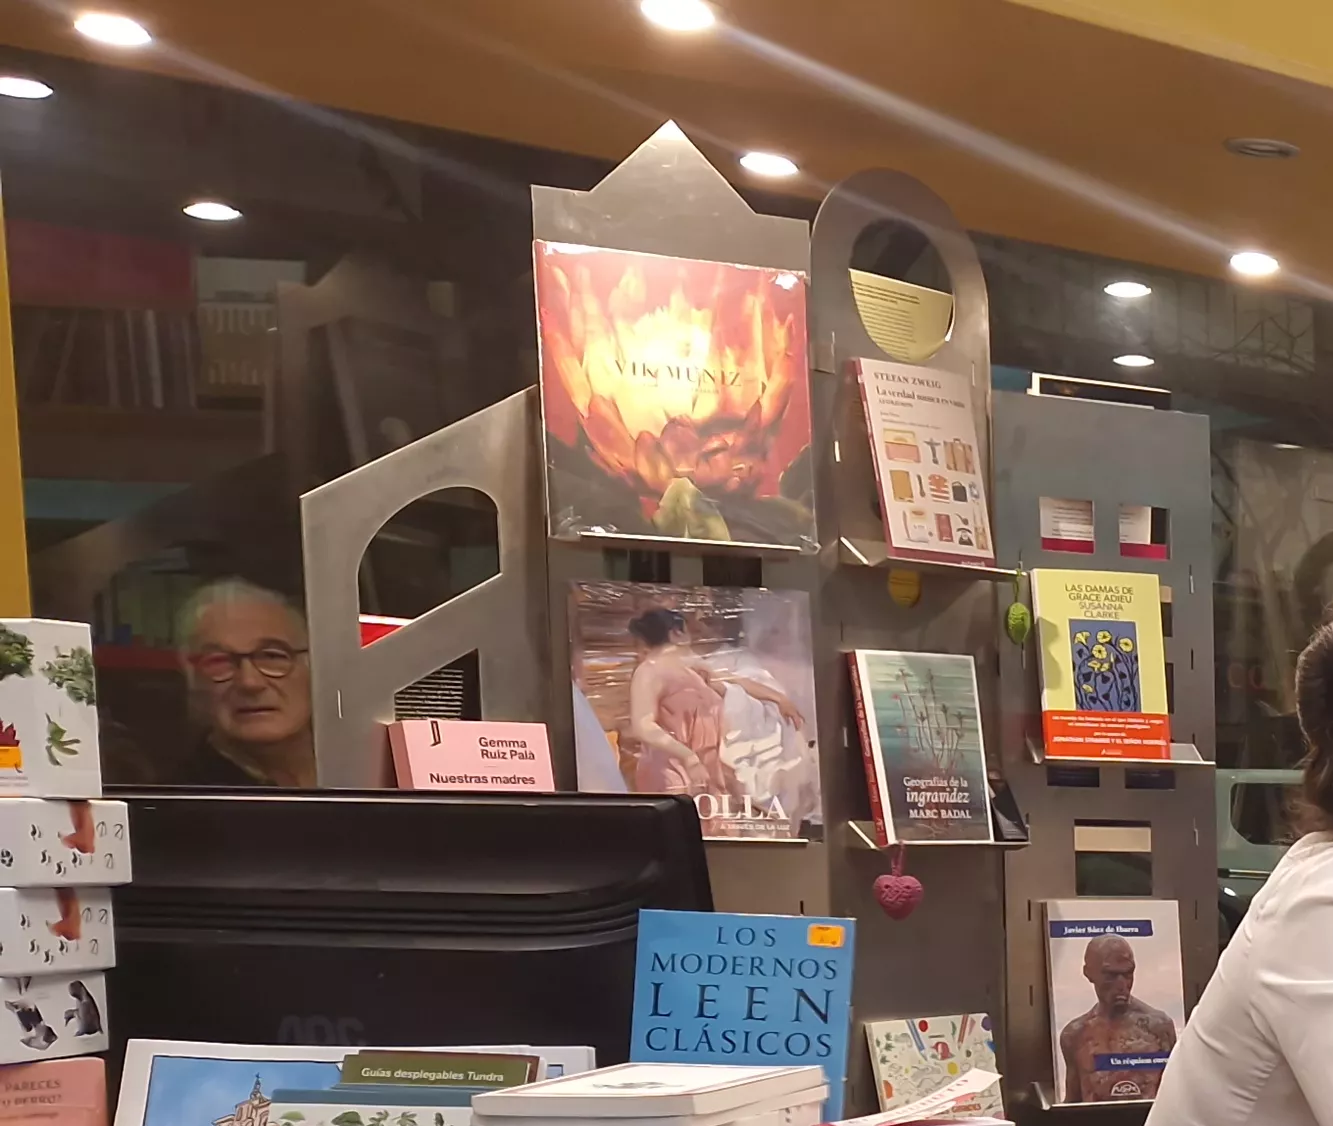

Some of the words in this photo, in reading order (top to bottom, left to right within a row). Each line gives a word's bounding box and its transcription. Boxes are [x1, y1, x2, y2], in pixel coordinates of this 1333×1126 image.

[615, 359, 659, 380] VIK
[874, 371, 909, 385] STEFAN
[1064, 583, 1083, 593] LAS
[1084, 584, 1119, 595] DAMAS
[1121, 586, 1134, 596] DE
[1068, 592, 1101, 602] GRACE
[1103, 593, 1133, 604] ADIEU
[1079, 601, 1124, 612] SUSANNA
[1083, 610, 1120, 620] CLARKE
[478, 736, 527, 749] Gemma
[481, 749, 508, 760] Ruiz
[429, 772, 489, 785] Nuestras
[490, 774, 536, 785] madres
[947, 777, 958, 788] de
[905, 788, 970, 806] ingravidez
[908, 808, 938, 819] MARC
[940, 809, 972, 820] BADAL
[716, 925, 776, 947] LOS
[650, 951, 838, 980] MODERNOS
[648, 981, 835, 1025] LEEN
[645, 1023, 832, 1058] CLÁSICOS
[361, 1067, 391, 1079] Guías
[393, 1069, 465, 1083] desplegables
[467, 1071, 505, 1083] Tundra
[5, 1079, 61, 1093] PARECES
